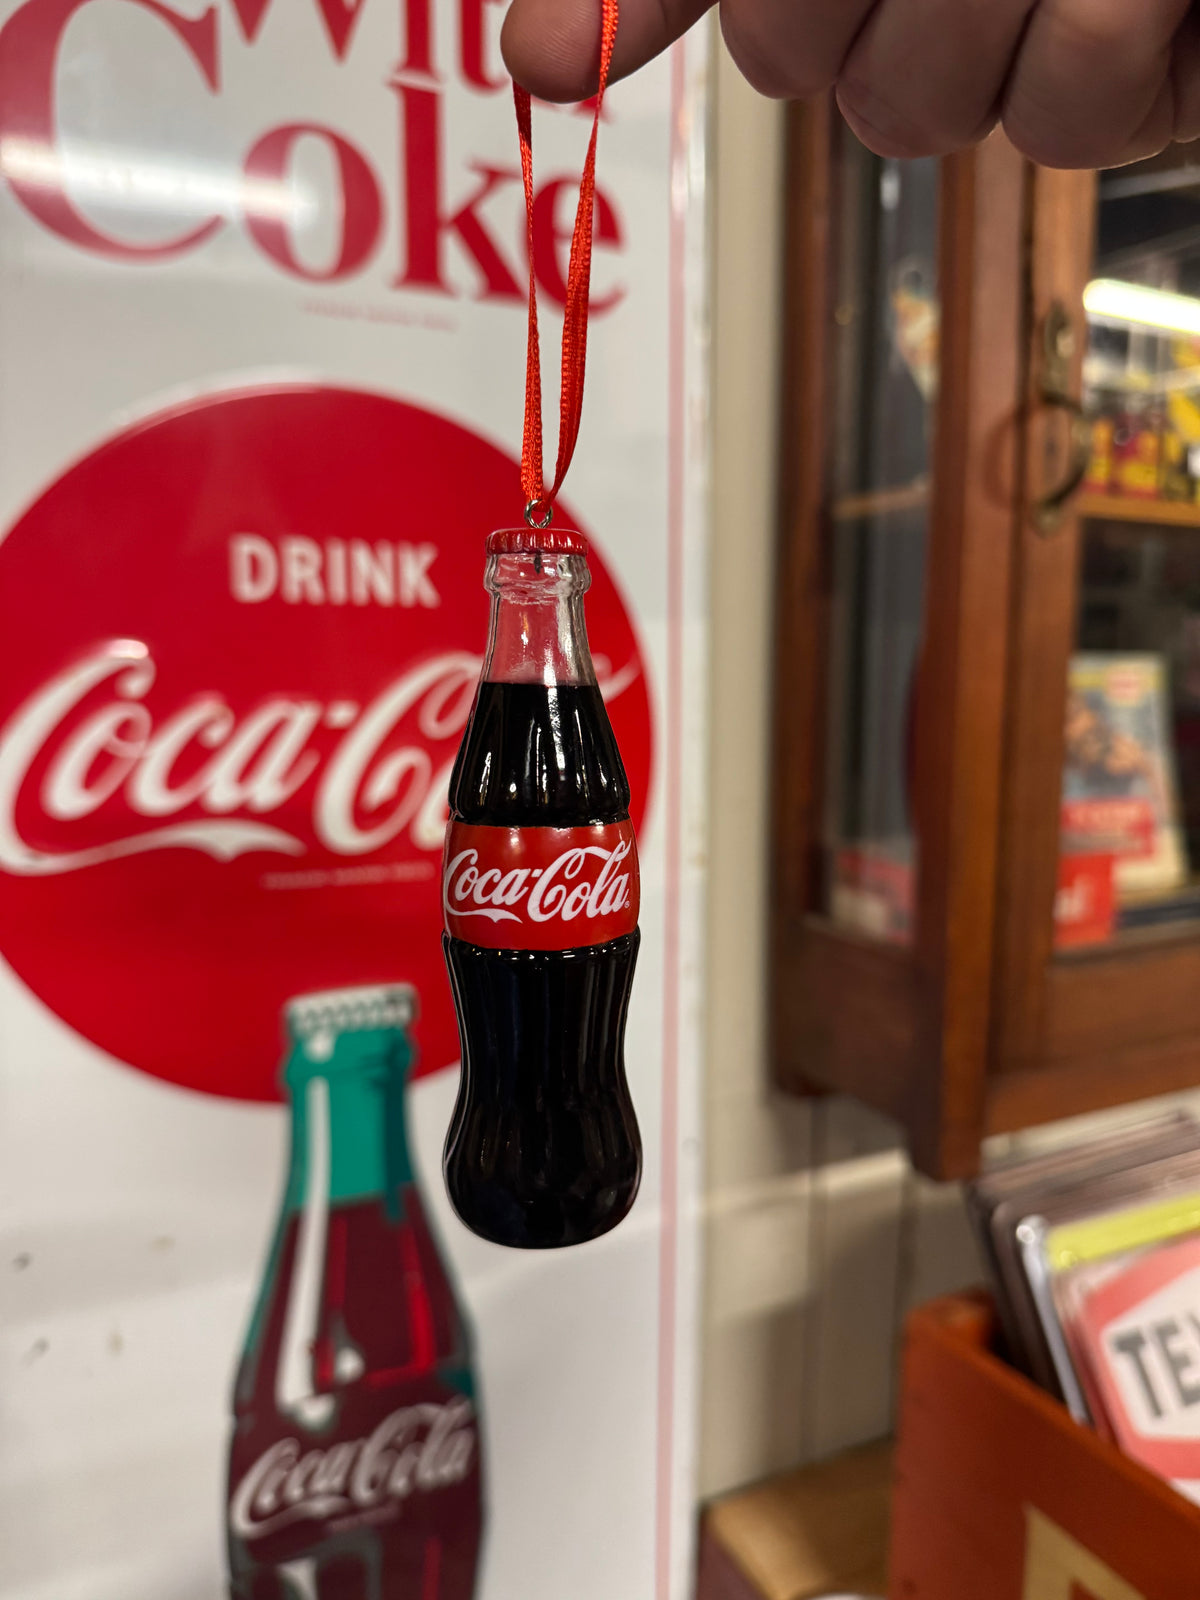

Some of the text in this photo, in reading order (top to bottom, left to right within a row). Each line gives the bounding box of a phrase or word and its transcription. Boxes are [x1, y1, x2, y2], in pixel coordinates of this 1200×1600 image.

[0, 0, 627, 319] Coke
[229, 533, 440, 607] DRINK
[0, 638, 641, 877] Coca-C
[443, 839, 631, 923] Coca-Cola
[1112, 1312, 1200, 1419] TE
